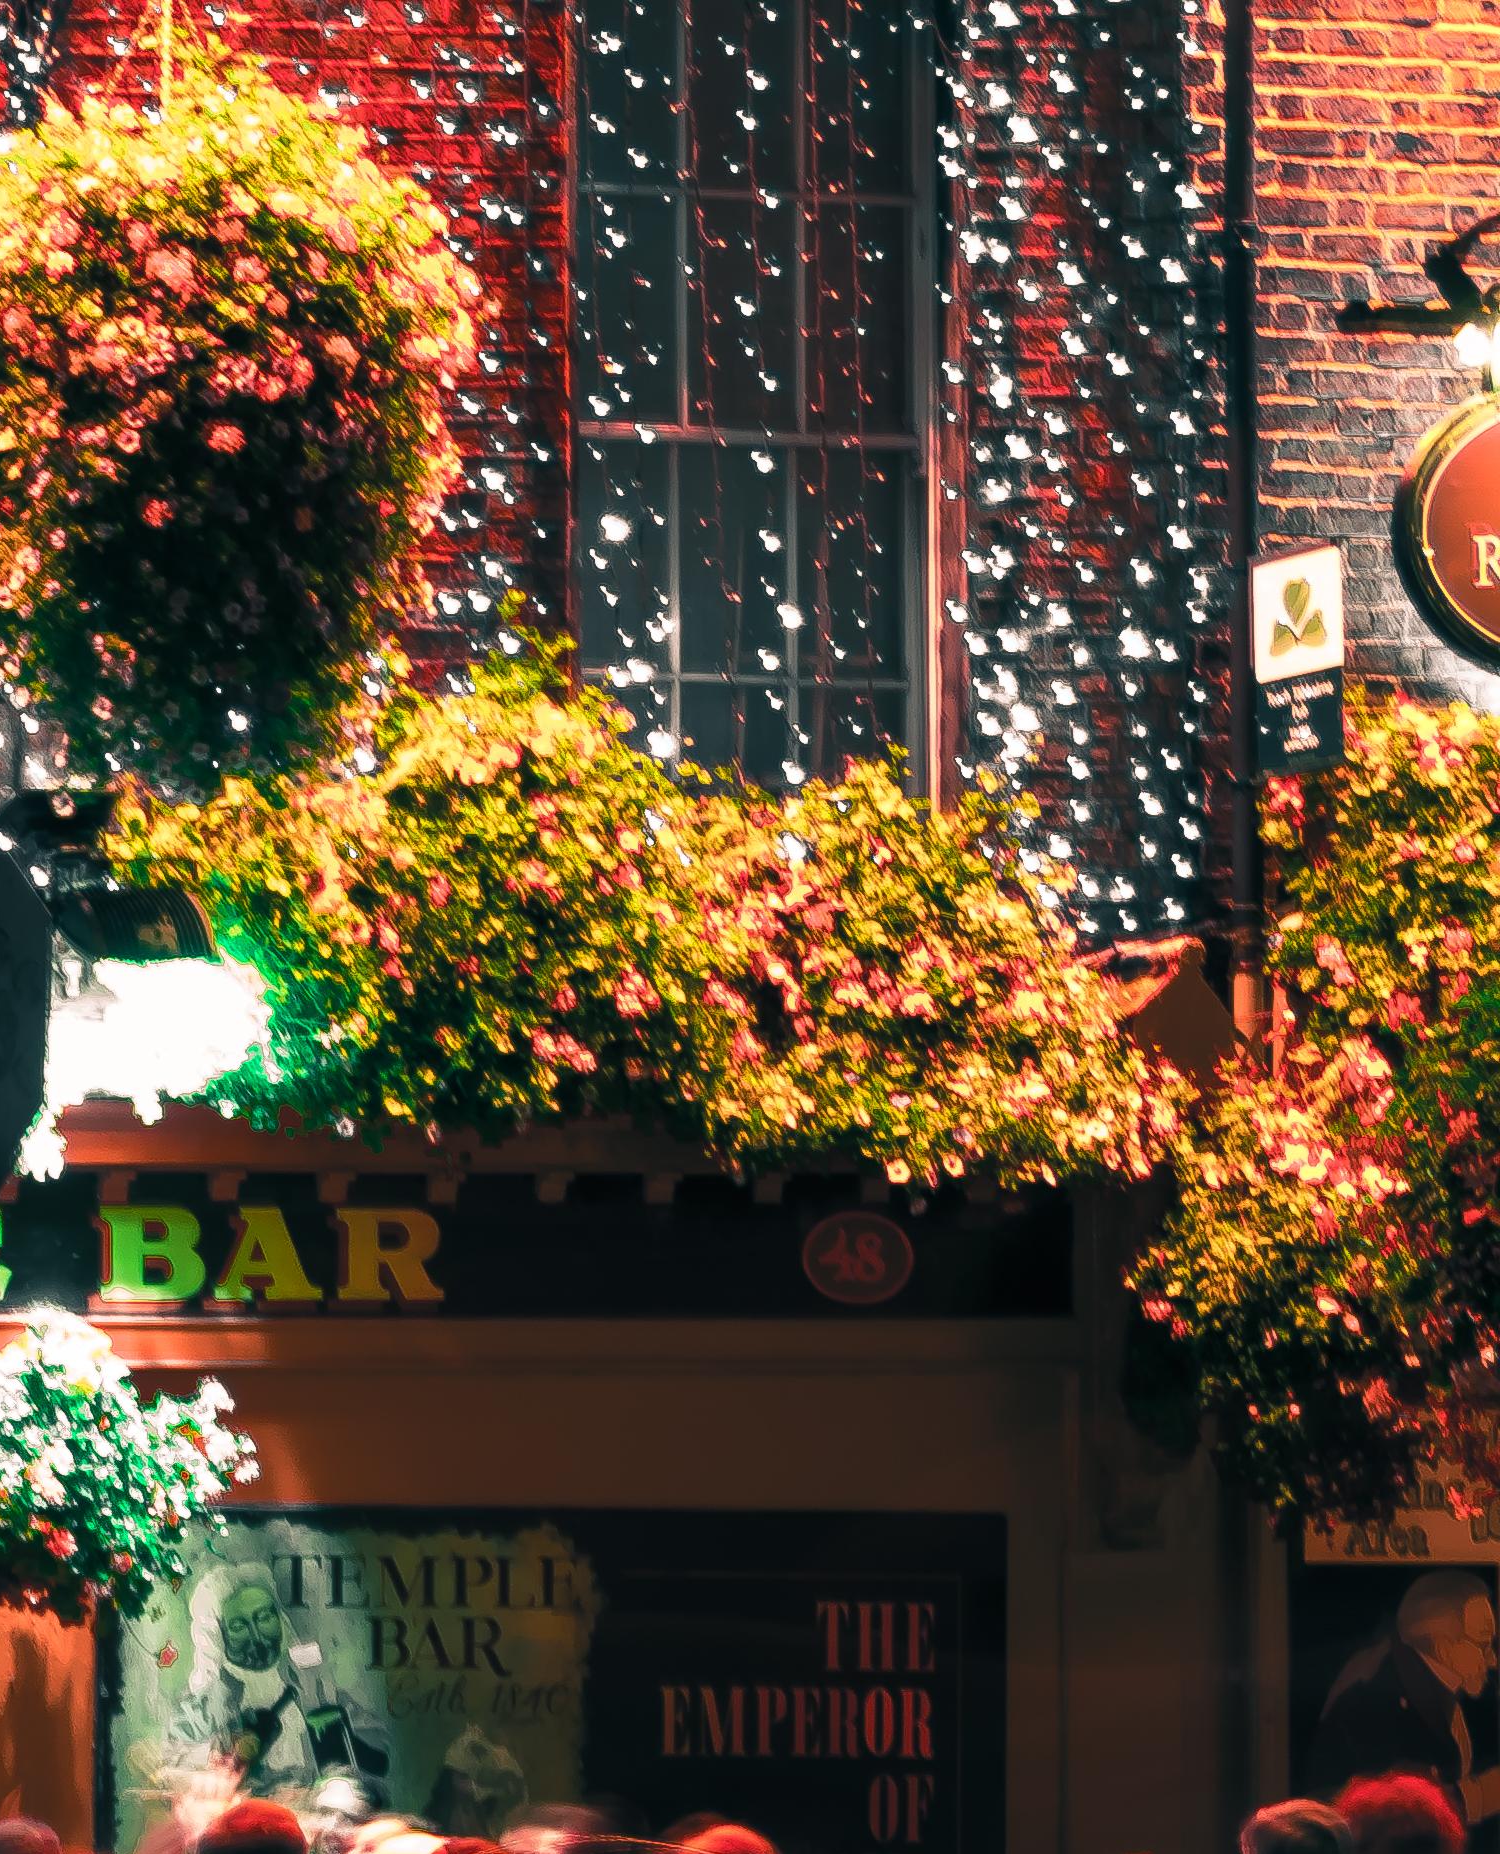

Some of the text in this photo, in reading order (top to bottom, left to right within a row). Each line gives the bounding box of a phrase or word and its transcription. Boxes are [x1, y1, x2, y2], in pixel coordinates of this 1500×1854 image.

[99, 1203, 443, 1303] BAR
[271, 1553, 582, 1609] TEMPLE
[367, 1614, 512, 1677] BAR
[816, 1600, 936, 1673] THE
[659, 1683, 936, 1760] EMPEROR
[867, 1773, 936, 1844] OF
